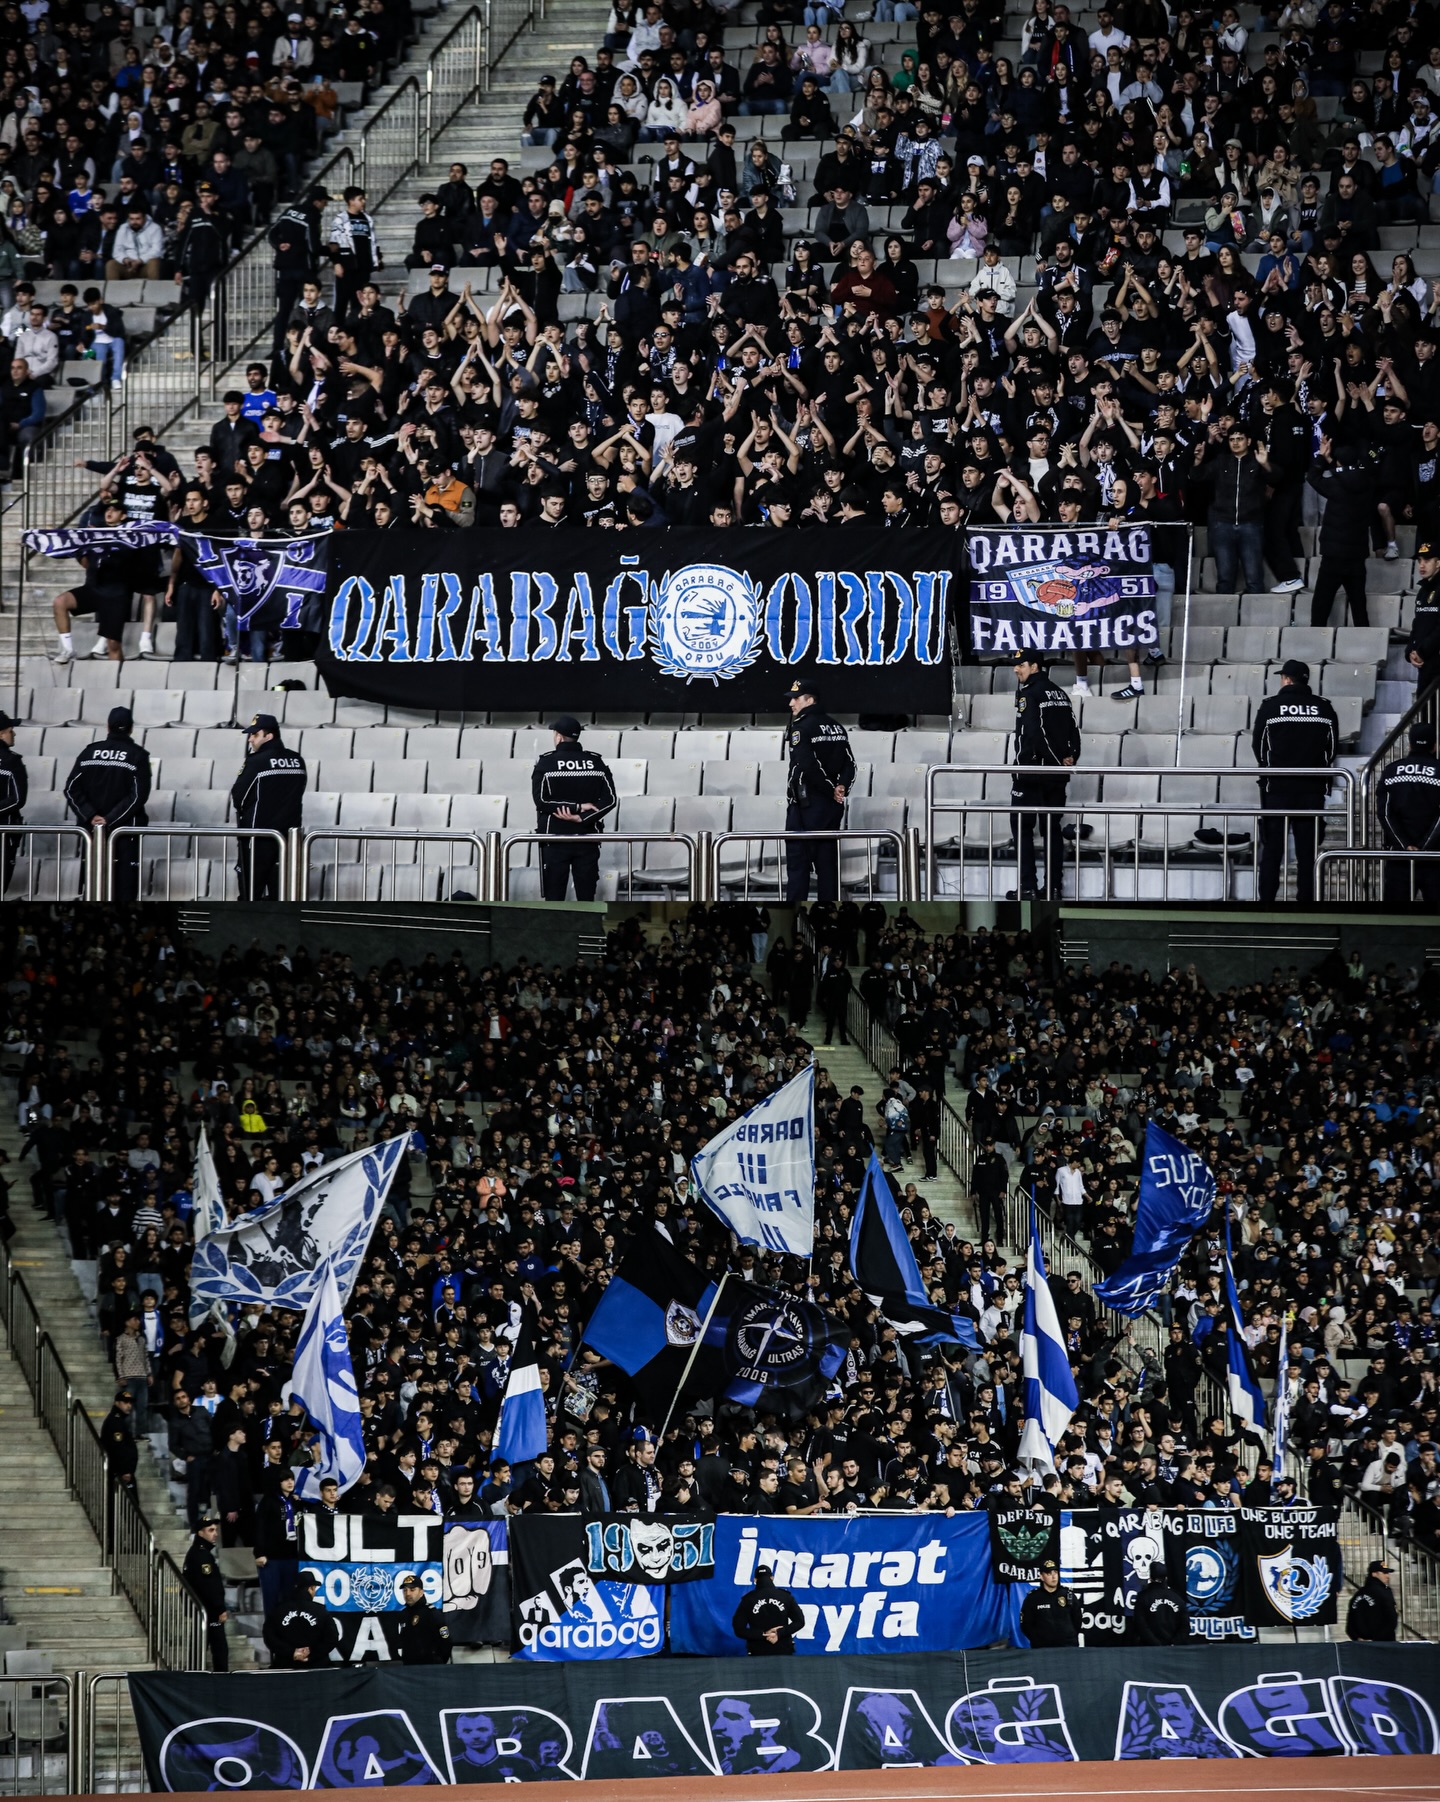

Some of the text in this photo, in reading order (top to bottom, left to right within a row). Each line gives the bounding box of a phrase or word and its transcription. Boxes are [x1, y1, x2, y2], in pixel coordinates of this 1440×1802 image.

[969, 526, 1151, 574] QARABAĞ
[675, 575, 735, 592] QARABAĞ
[977, 582, 1007, 600] 19
[1121, 577, 1150, 595] 51
[328, 555, 648, 662] QARABAĞ
[765, 571, 952, 665] ORDU
[972, 610, 1158, 650] FANATICS
[685, 652, 724, 663] ORDU
[767, 1345, 804, 1364] ULTRAS
[735, 1366, 768, 1384] 2009
[996, 1509, 1054, 1527] DEFEND
[1241, 1508, 1318, 1524] ONE BLOOD
[1204, 1515, 1237, 1538] LIFE
[1264, 1523, 1336, 1540] ONE TEAM
[303, 1513, 443, 1562] ULT
[790, 1591, 920, 1652] ayfa
[518, 1616, 661, 1653] qarabag
